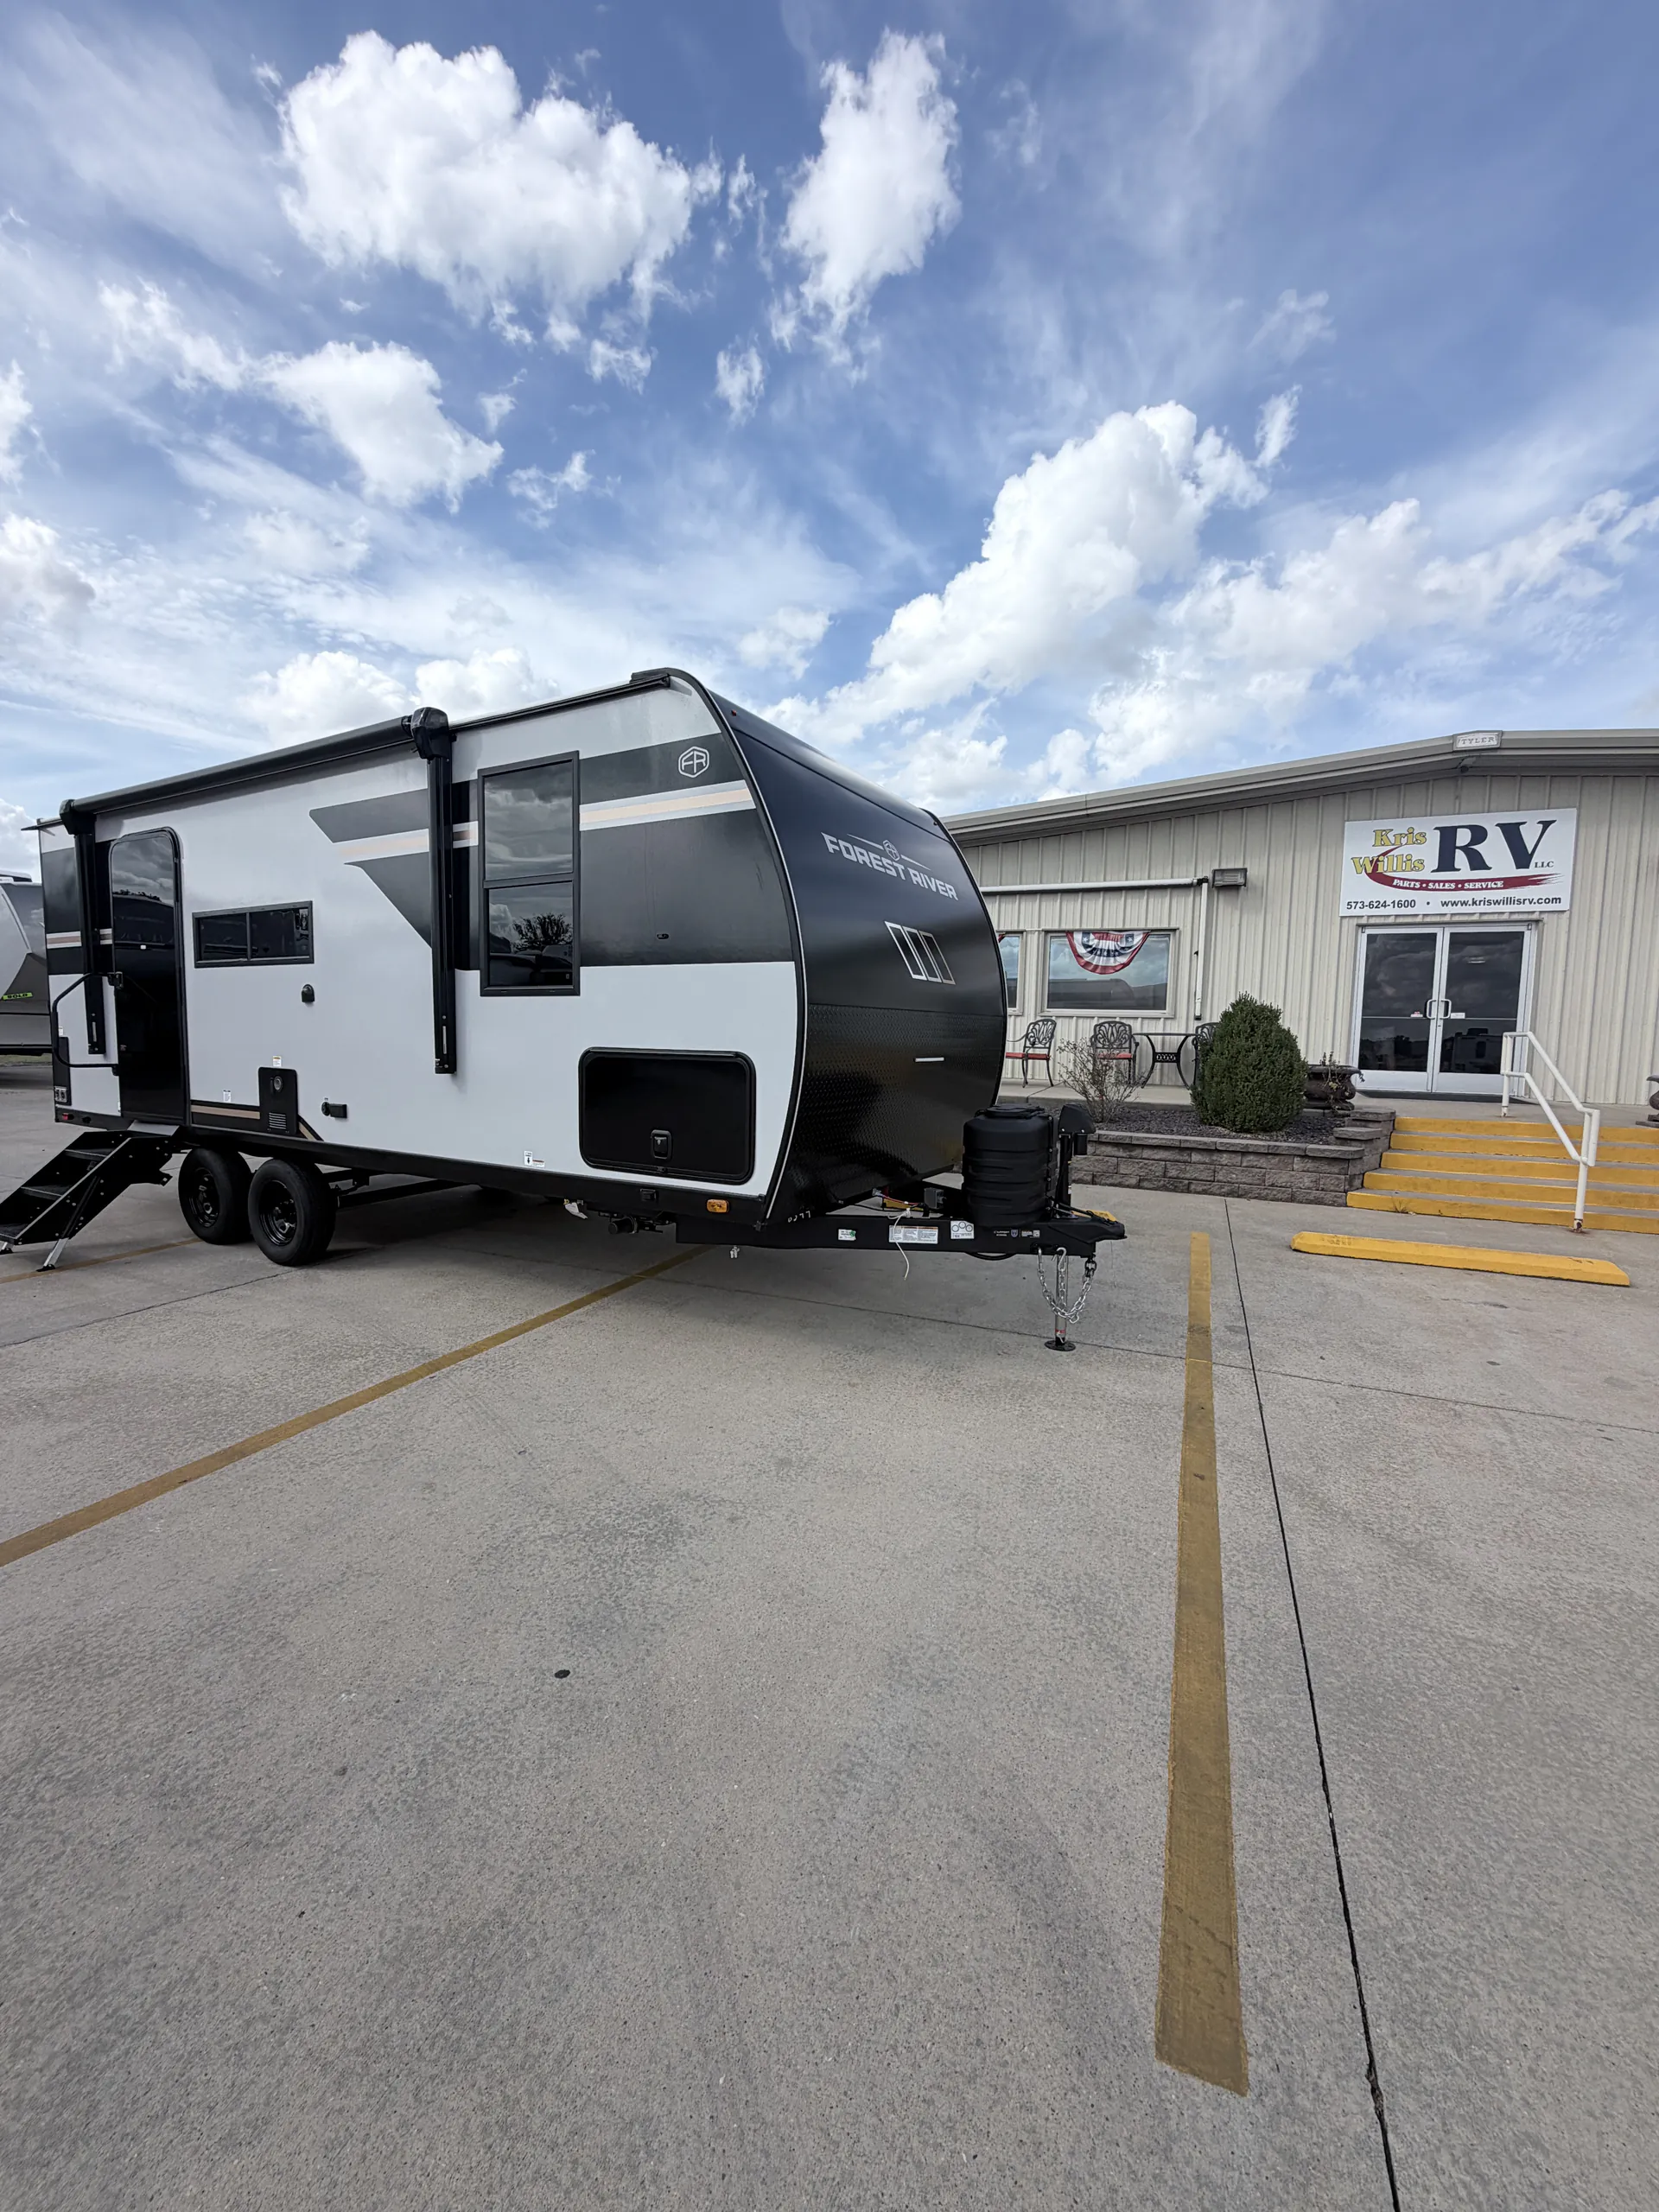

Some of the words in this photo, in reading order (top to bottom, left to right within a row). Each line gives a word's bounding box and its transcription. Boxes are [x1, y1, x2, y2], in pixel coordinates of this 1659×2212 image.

[1372, 827, 1427, 847] Kris
[1431, 820, 1557, 873] RV
[821, 831, 907, 880] FOREST
[907, 867, 958, 900] RIVER
[1351, 854, 1426, 874] Willis
[1392, 878, 1421, 888] PARTS
[1464, 880, 1504, 889] SERVICE
[1346, 899, 1416, 910] 573-624-1600
[1440, 896, 1561, 908] www.kriswillisrv.com
